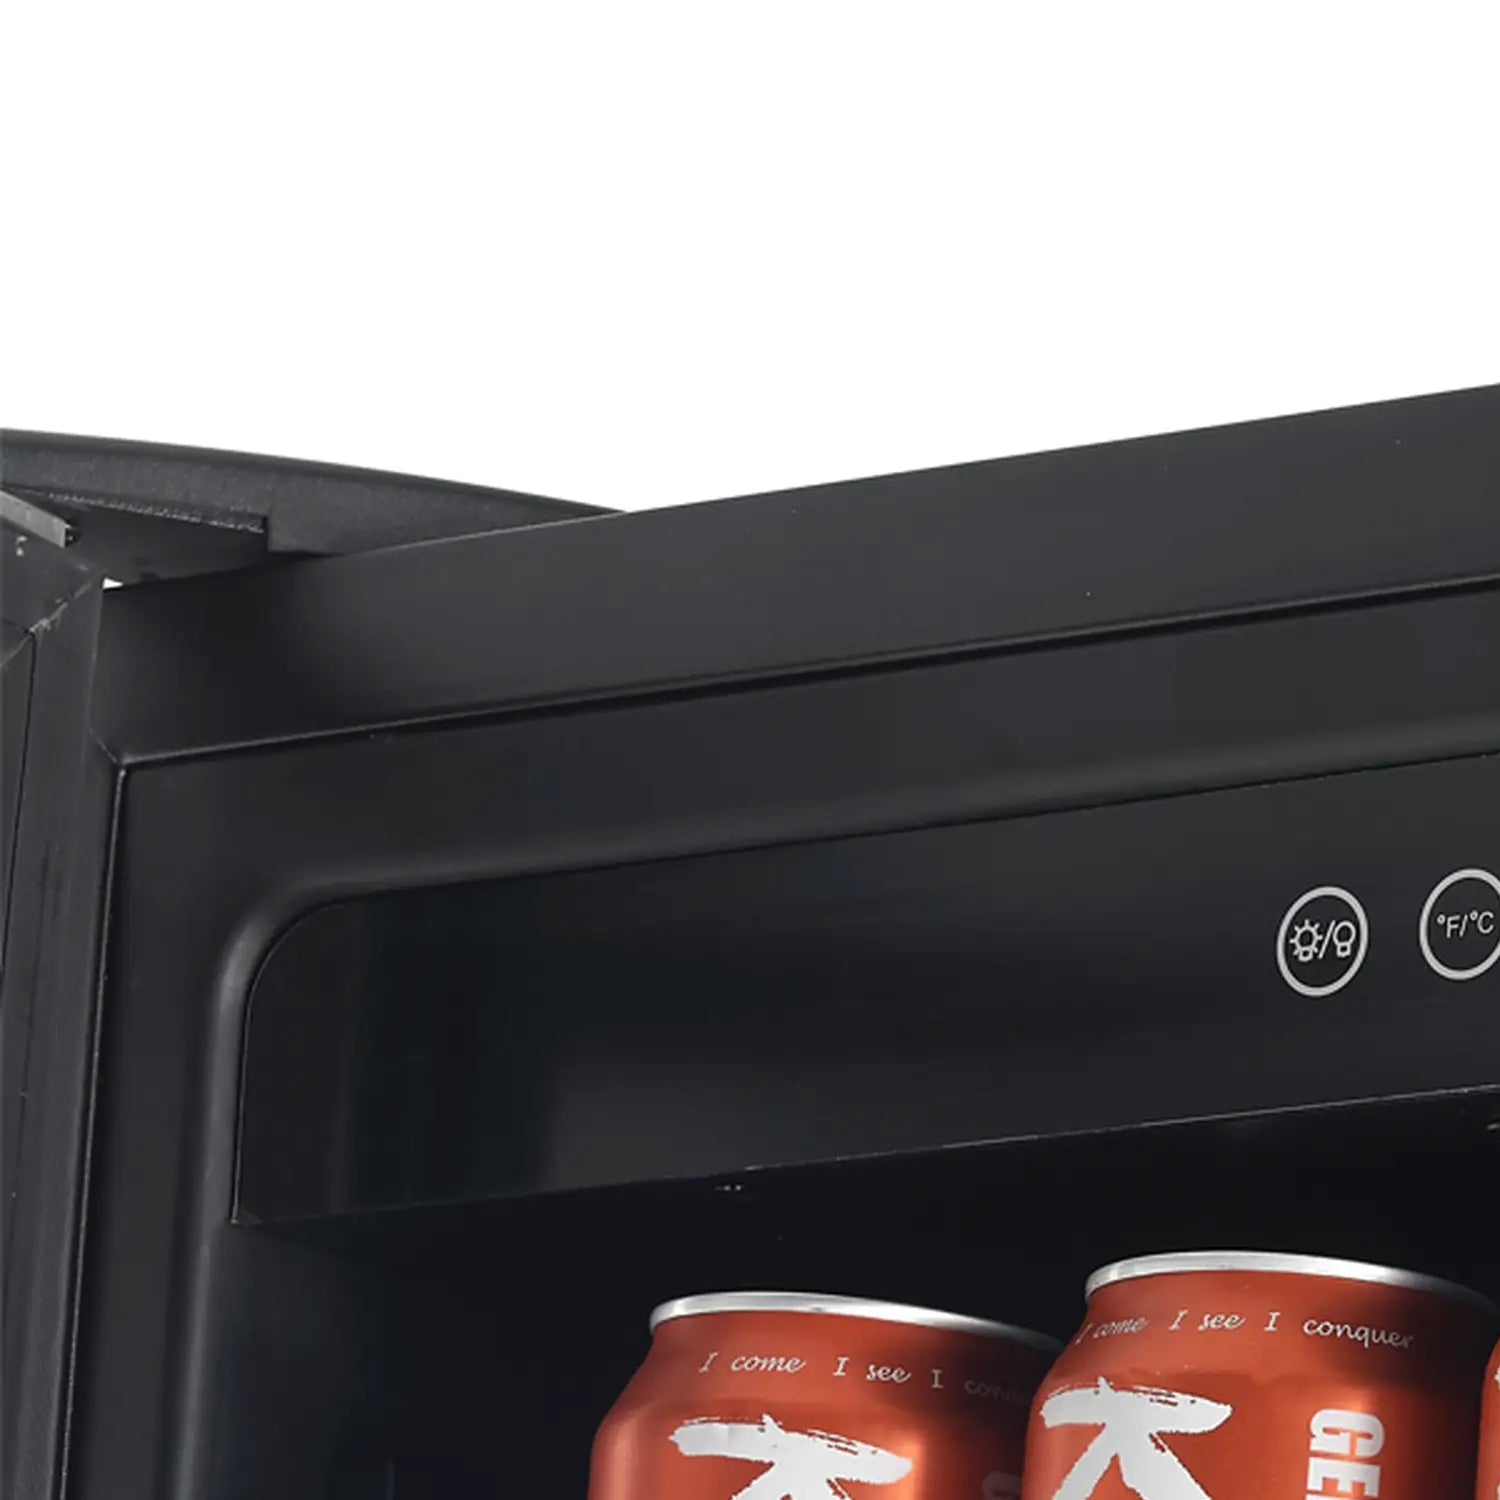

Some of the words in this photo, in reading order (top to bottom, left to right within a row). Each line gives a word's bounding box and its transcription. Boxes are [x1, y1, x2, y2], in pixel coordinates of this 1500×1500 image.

[1168, 1309, 1188, 1330] I
[1198, 1313, 1246, 1331] see
[1264, 1311, 1280, 1332] I
[1303, 1317, 1414, 1348] conquer
[699, 1352, 718, 1374] I
[730, 1354, 806, 1373] come
[833, 1356, 850, 1376] I
[866, 1362, 912, 1384] see
[931, 1368, 944, 1389] I
